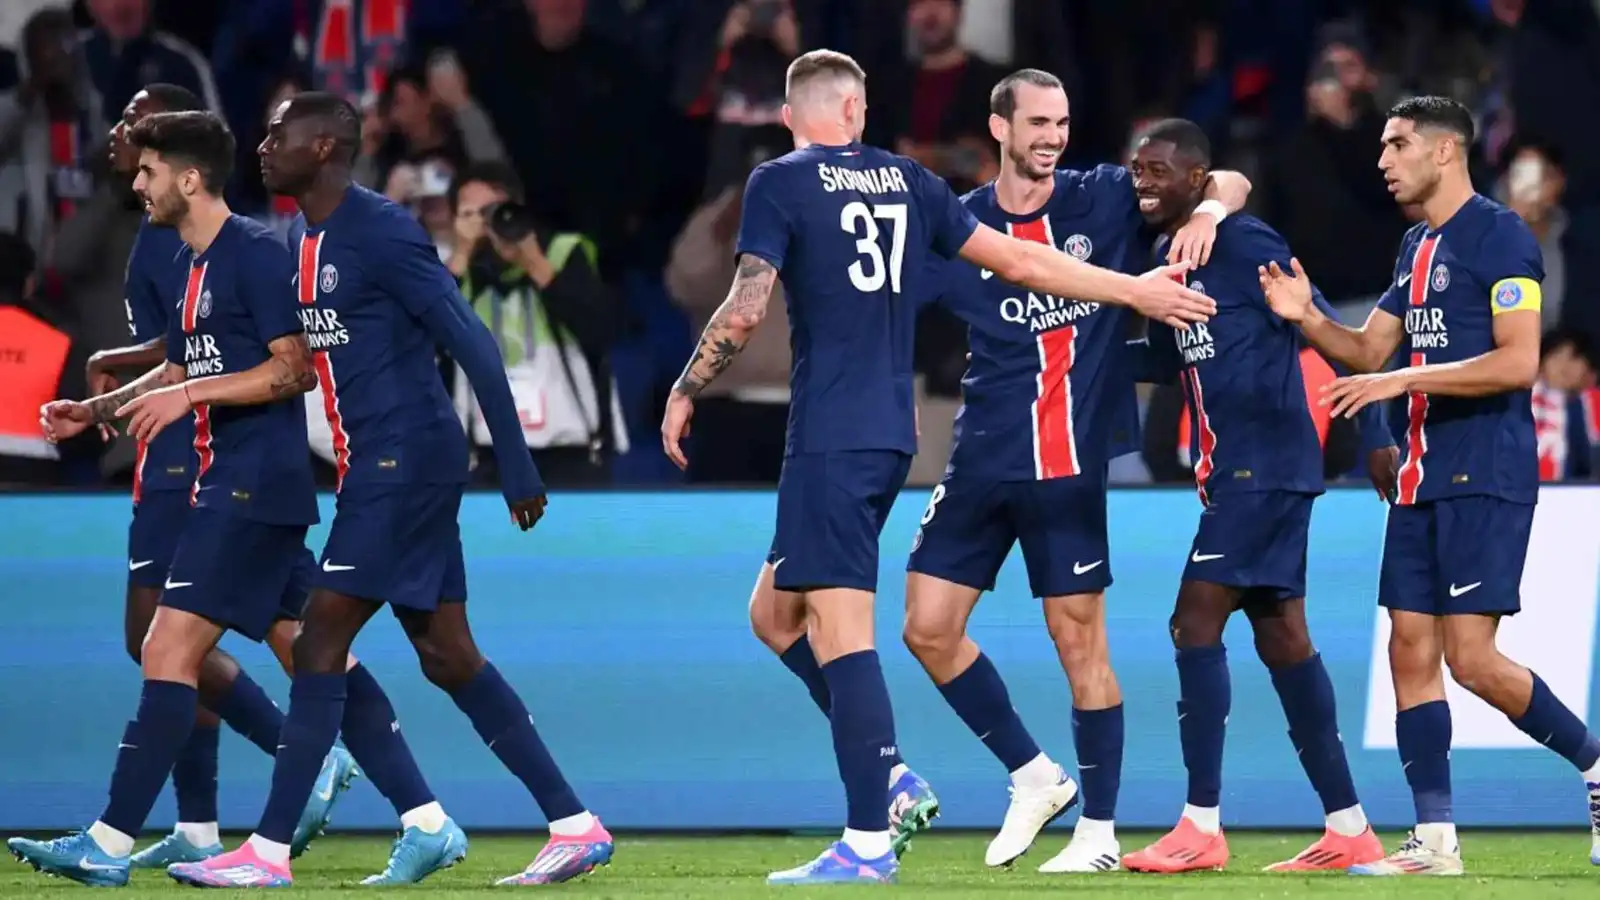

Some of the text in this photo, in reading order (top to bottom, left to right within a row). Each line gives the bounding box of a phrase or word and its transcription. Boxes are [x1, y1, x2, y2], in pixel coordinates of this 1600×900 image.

[817, 162, 908, 194] ŠKRINIAR
[840, 201, 908, 293] 37
[295, 308, 345, 331] ATAR
